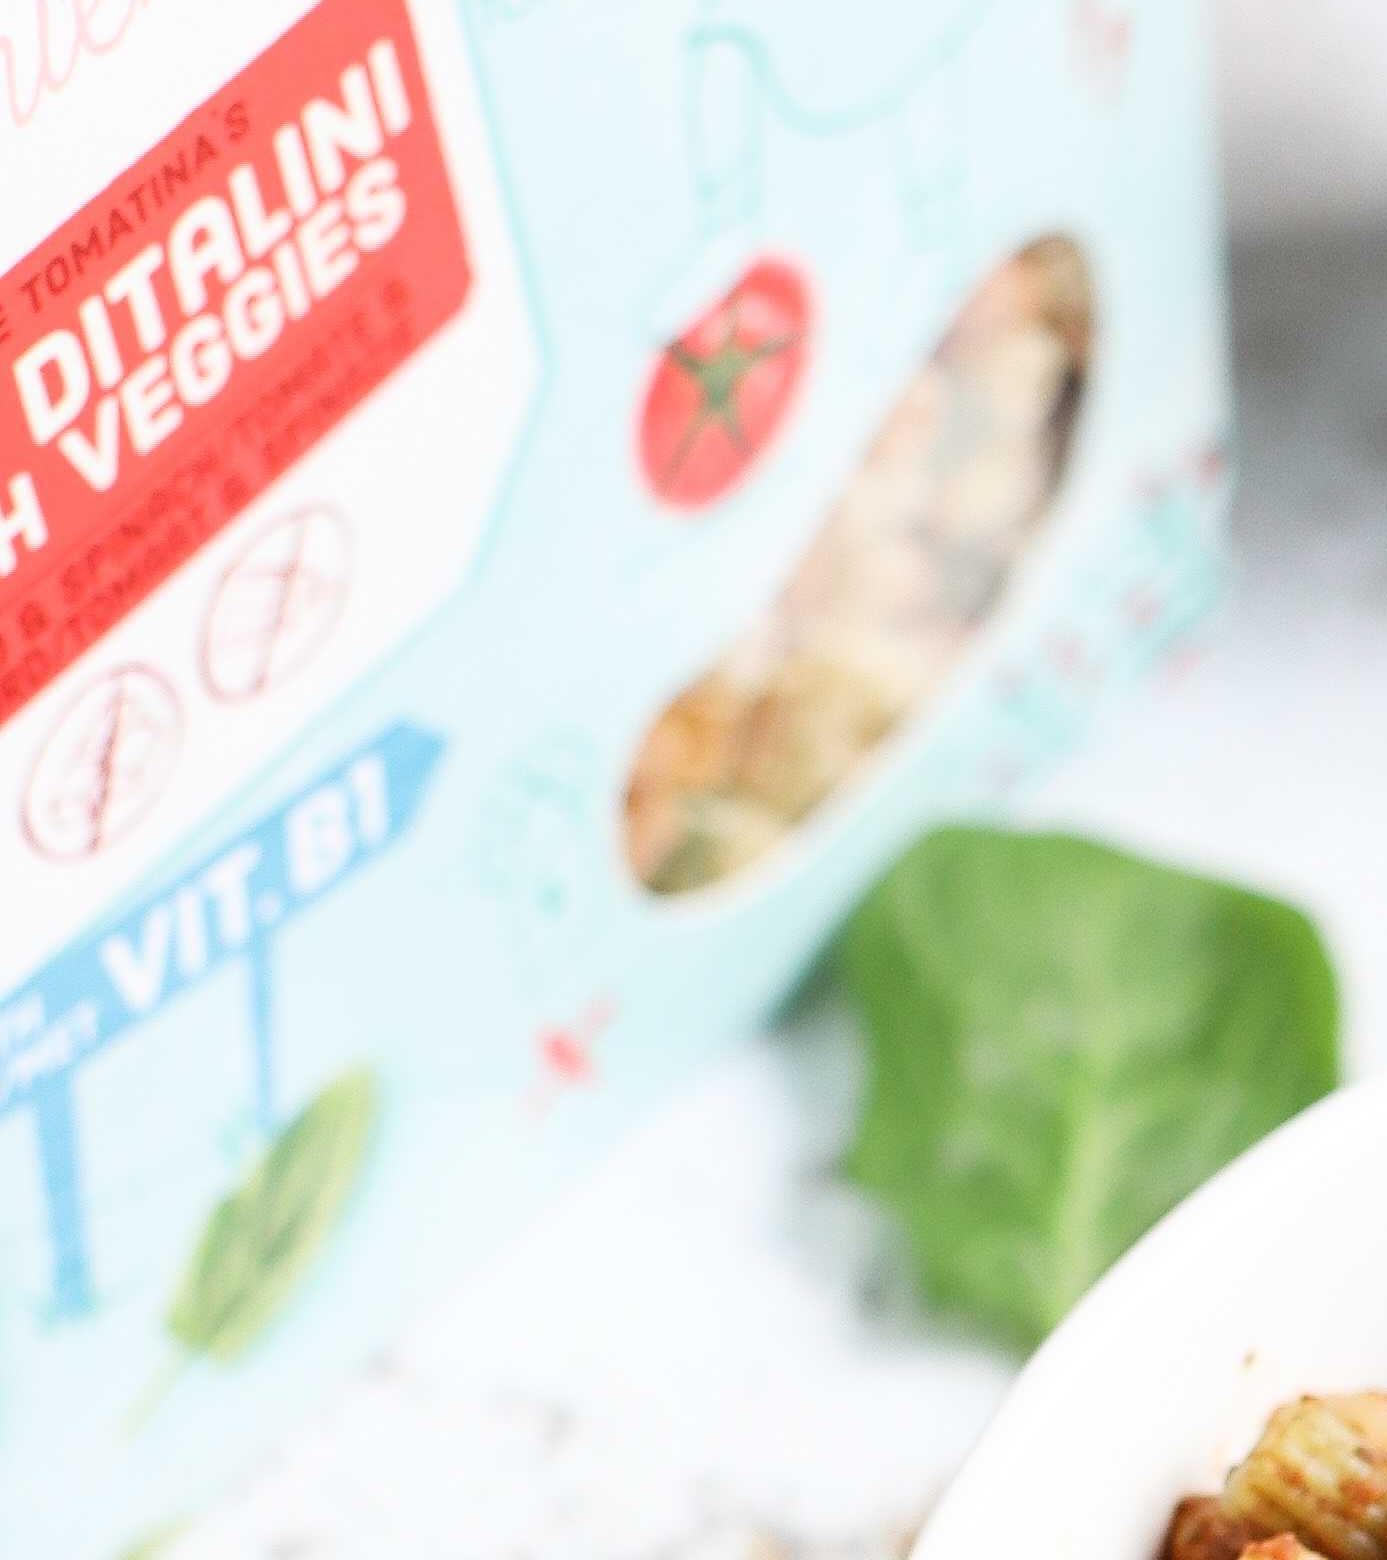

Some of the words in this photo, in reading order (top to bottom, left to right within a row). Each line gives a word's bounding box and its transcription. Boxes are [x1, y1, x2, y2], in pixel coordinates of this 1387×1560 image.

[12, 39, 411, 446] DITALINI
[20, 99, 250, 314] TOMATINA'S
[57, 158, 407, 493] VEGGIES
